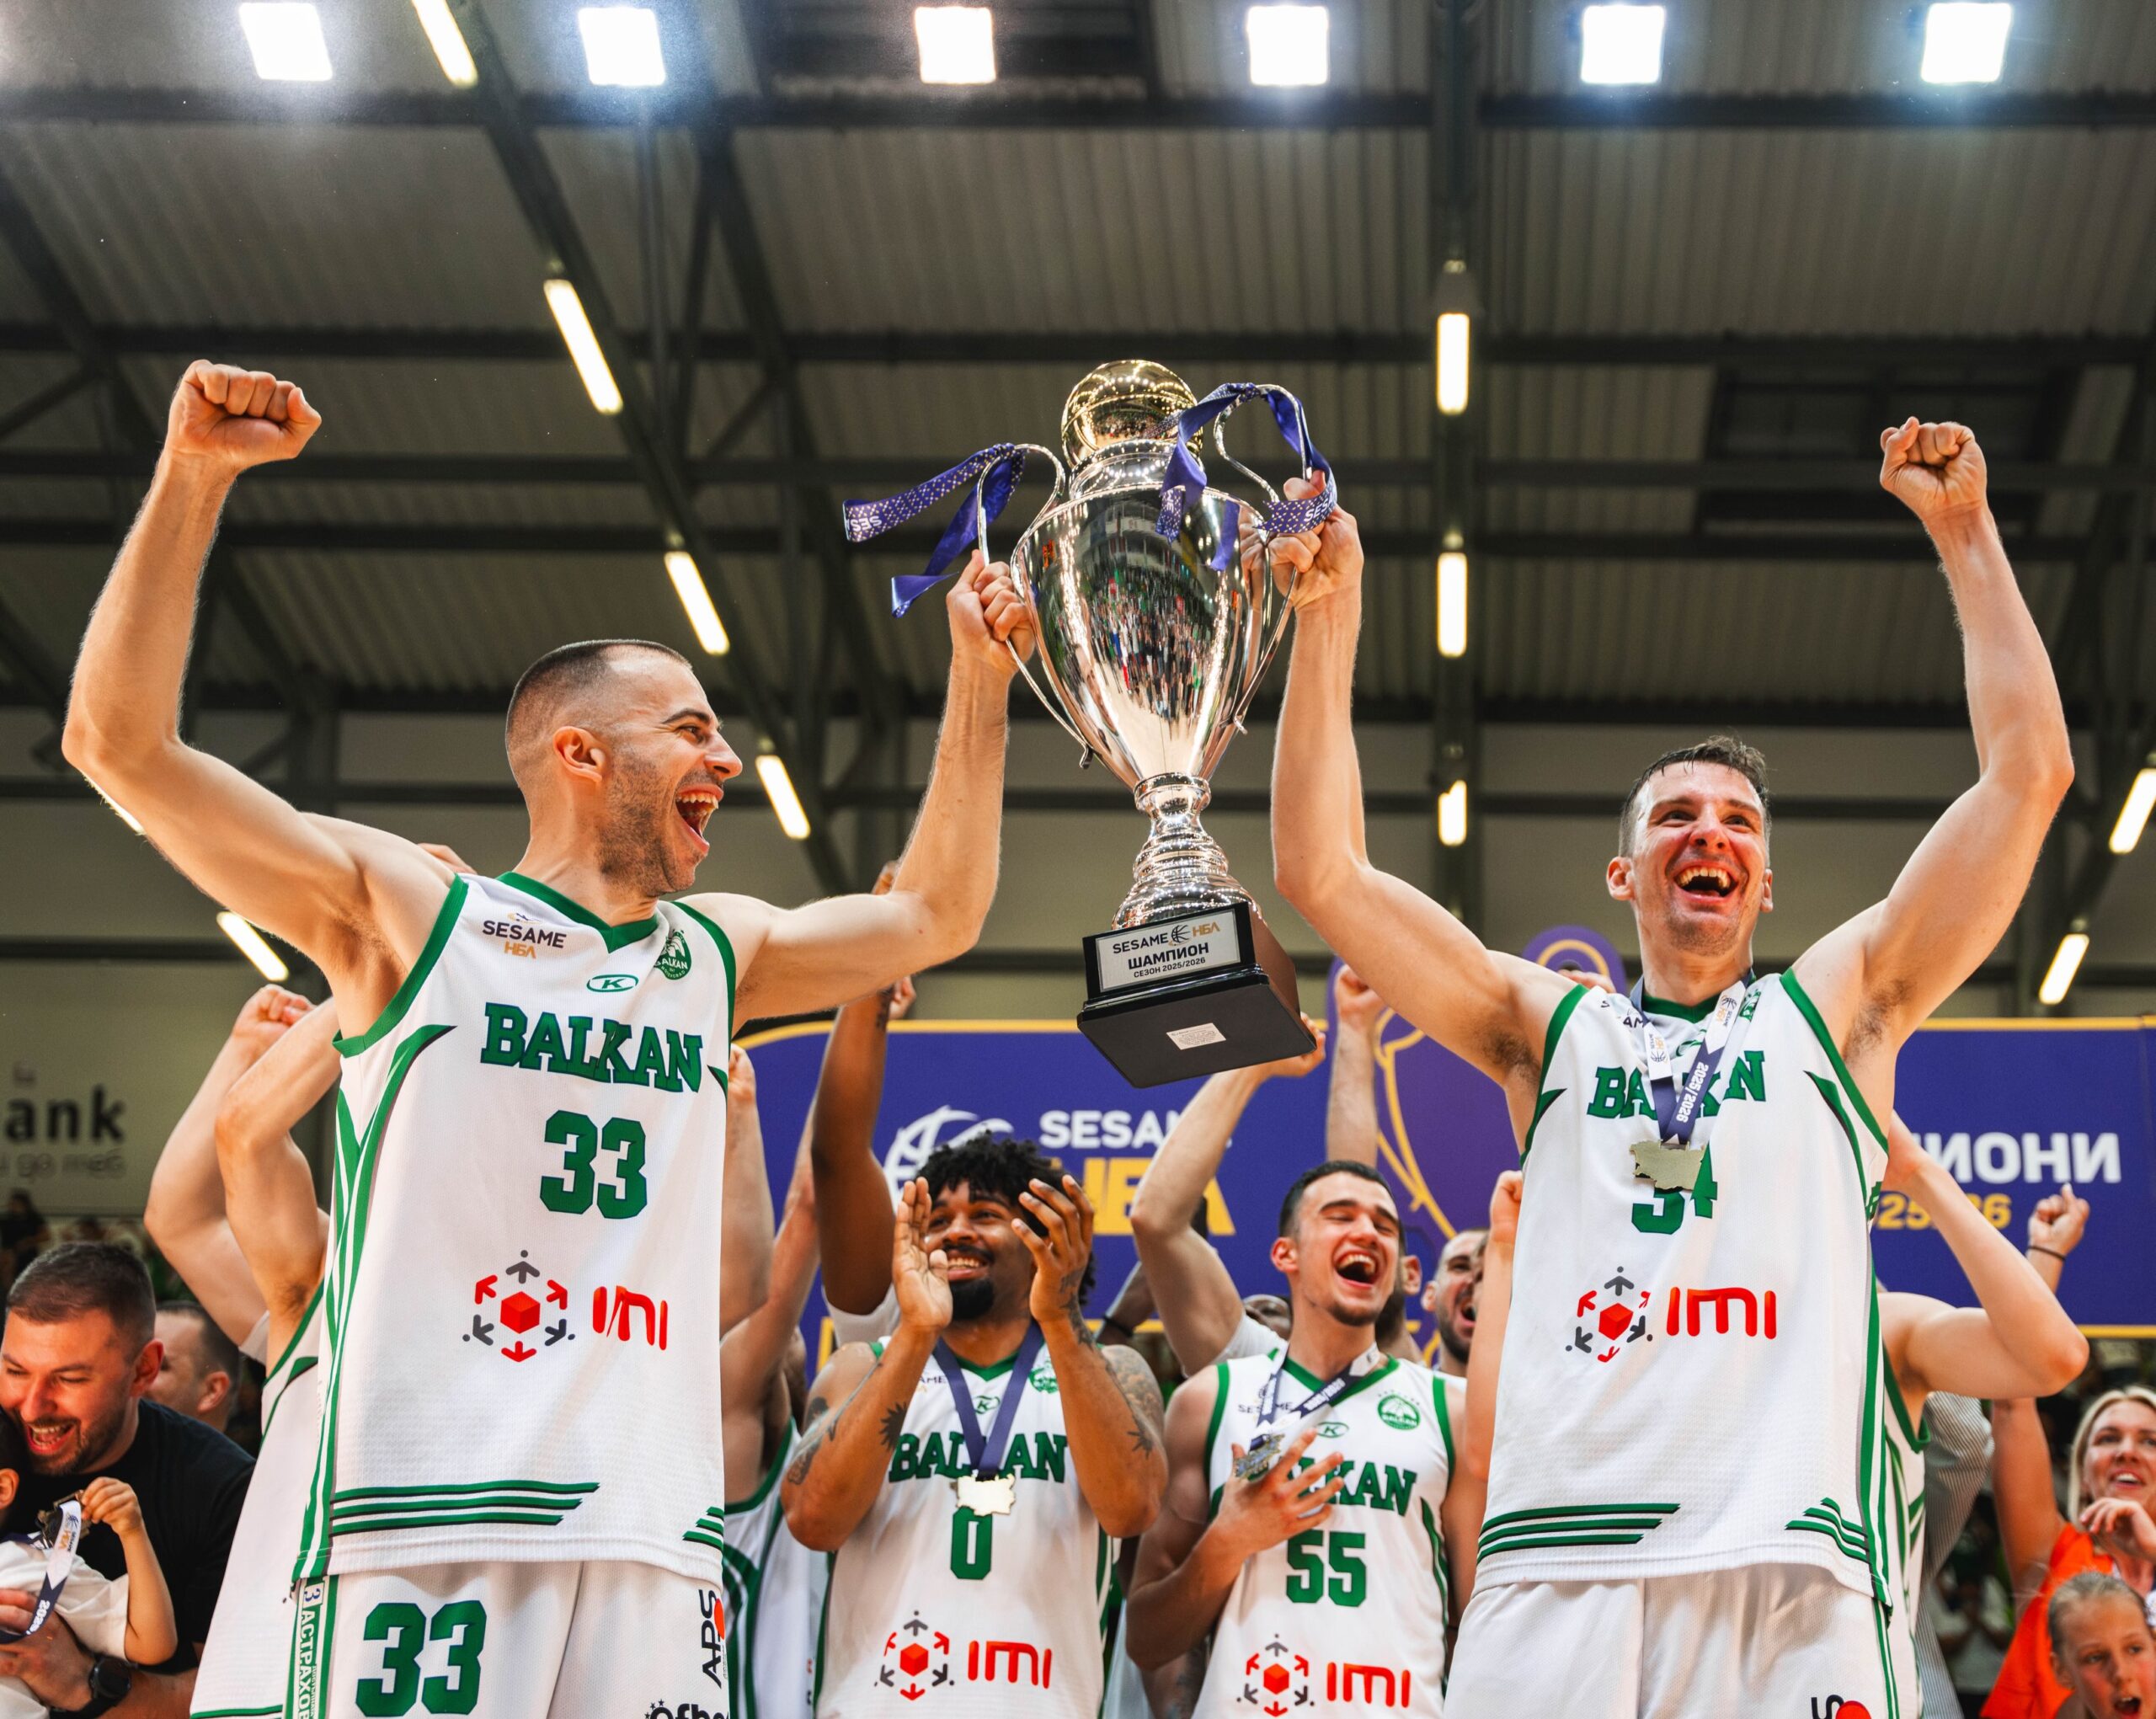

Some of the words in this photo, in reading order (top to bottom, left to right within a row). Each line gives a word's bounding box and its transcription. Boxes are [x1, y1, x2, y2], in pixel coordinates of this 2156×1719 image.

[846, 515, 882, 532] SES
[482, 919, 567, 948] SESAME
[1113, 932, 1168, 954] SESAME
[1129, 942, 1209, 970] ШАМПИОН
[1134, 966, 1161, 979] СЕЗОН
[1162, 957, 1206, 972] 2025/2026
[480, 1001, 704, 1093] BALKAN
[1587, 1050, 1766, 1120] BAKN
[1676, 1062, 1709, 1123] 2025/2026
[1039, 1110, 1233, 1149] SESA
[540, 1109, 648, 1220] 33
[1913, 1132, 2121, 1184] ИОНИ
[888, 1431, 1068, 1484] BALAN
[950, 1505, 993, 1580] 0
[1286, 1529, 1367, 1607] 55
[355, 1599, 487, 1718] 33
